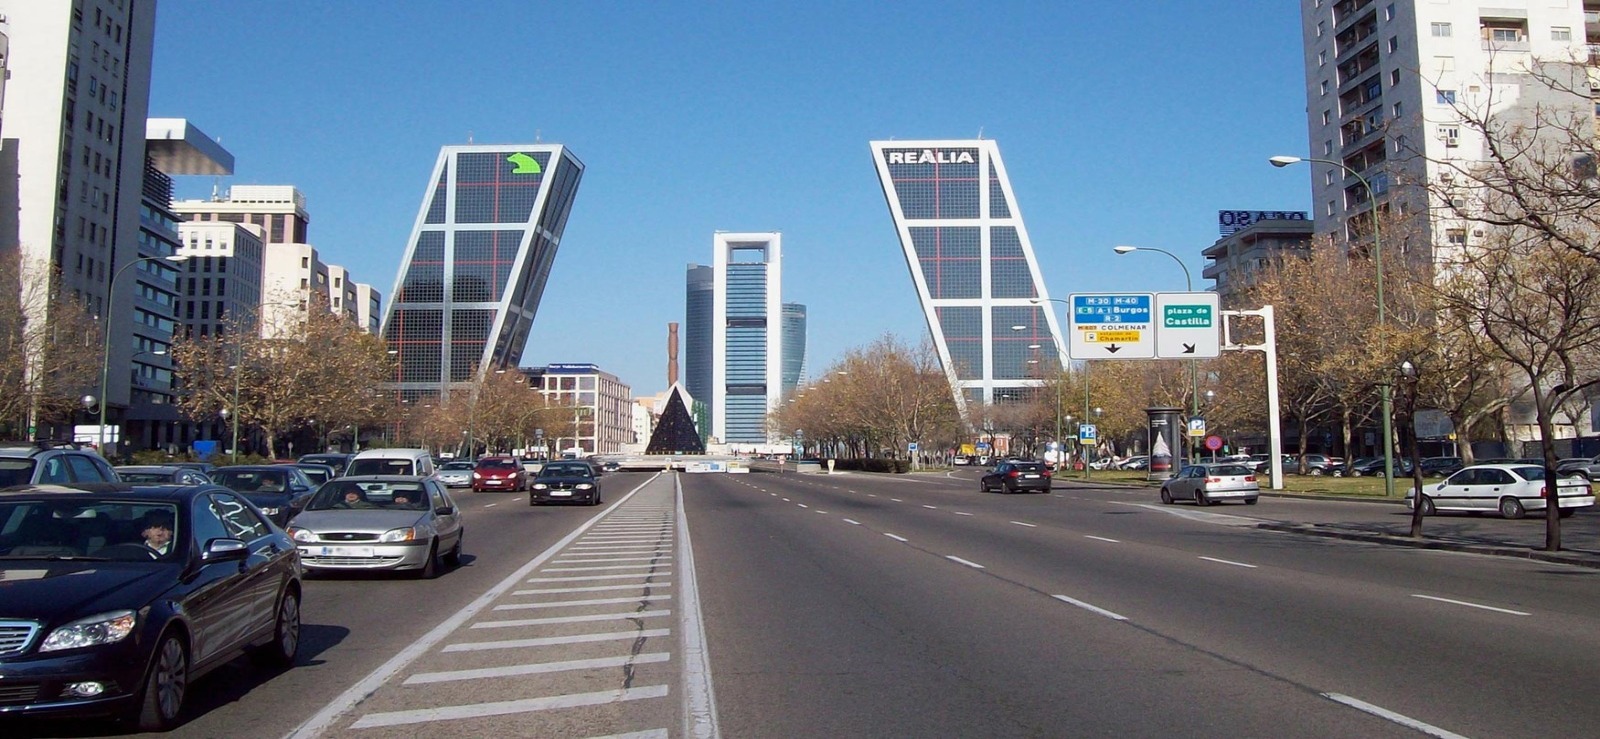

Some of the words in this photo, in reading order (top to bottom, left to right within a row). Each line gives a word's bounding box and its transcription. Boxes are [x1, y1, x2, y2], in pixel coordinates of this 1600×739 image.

[889, 149, 975, 164] REALIA
[1088, 297, 1109, 305] M-30
[1115, 297, 1137, 305] M-40
[1113, 306, 1149, 314] Burgos
[1166, 317, 1210, 325] Castilla
